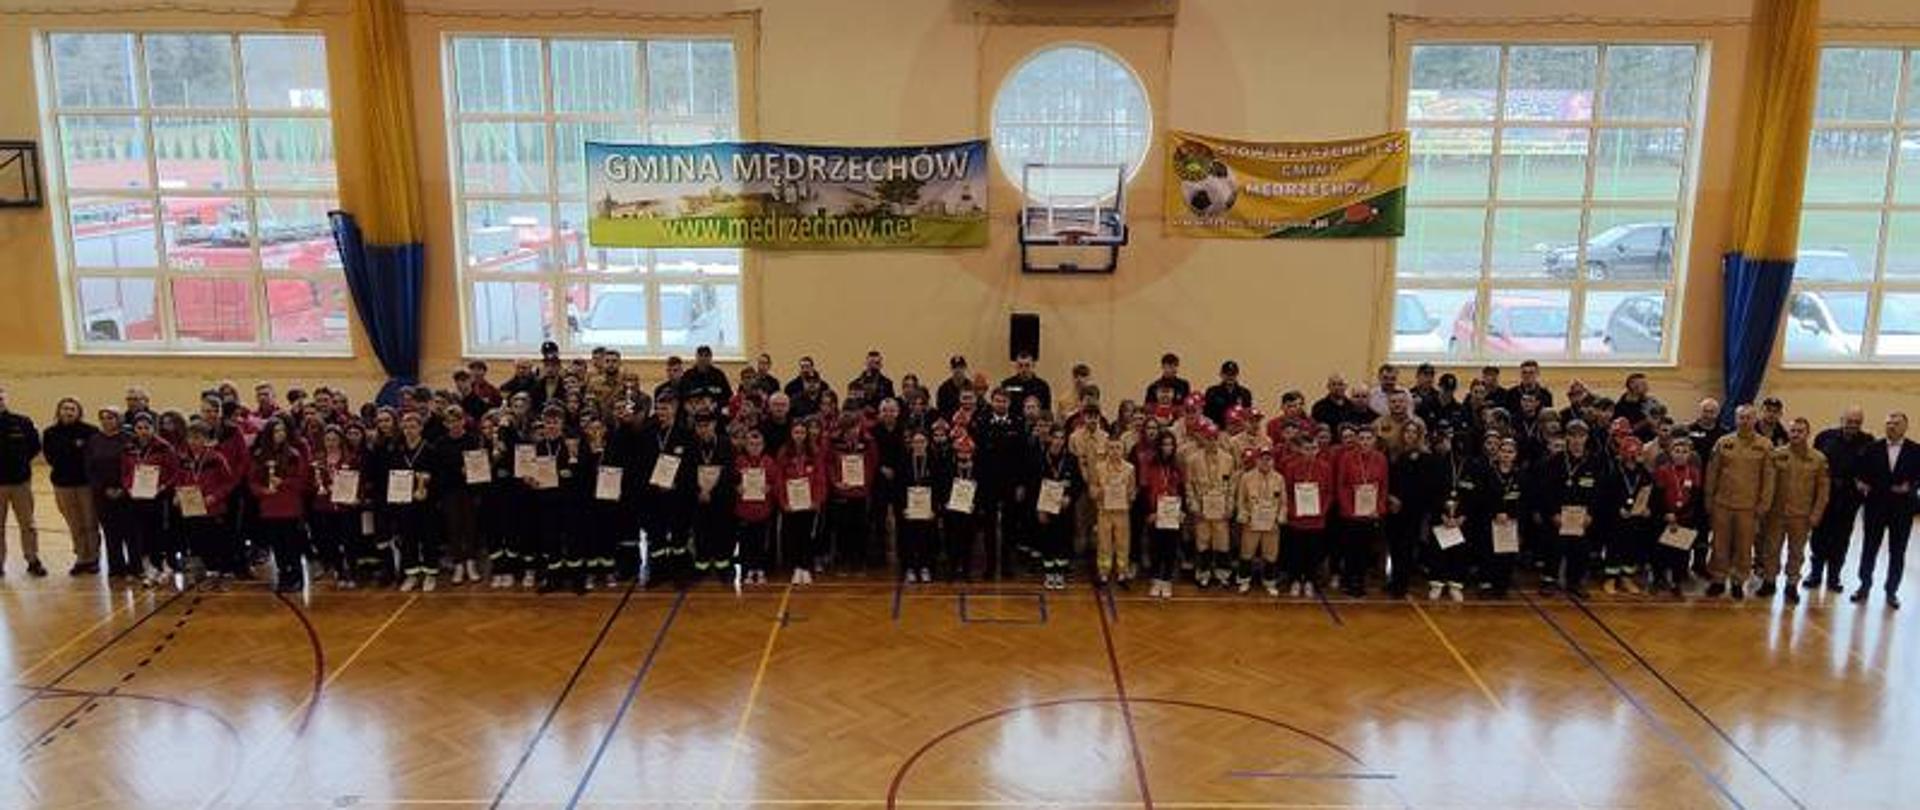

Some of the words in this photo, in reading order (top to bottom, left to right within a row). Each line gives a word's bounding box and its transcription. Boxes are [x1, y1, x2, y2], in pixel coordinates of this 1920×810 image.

[605, 153, 721, 182] GMINA
[732, 147, 968, 186] MĘDRZECHÓW
[1281, 161, 1341, 177] GMINY
[663, 210, 918, 243] www.medrzechow.net
